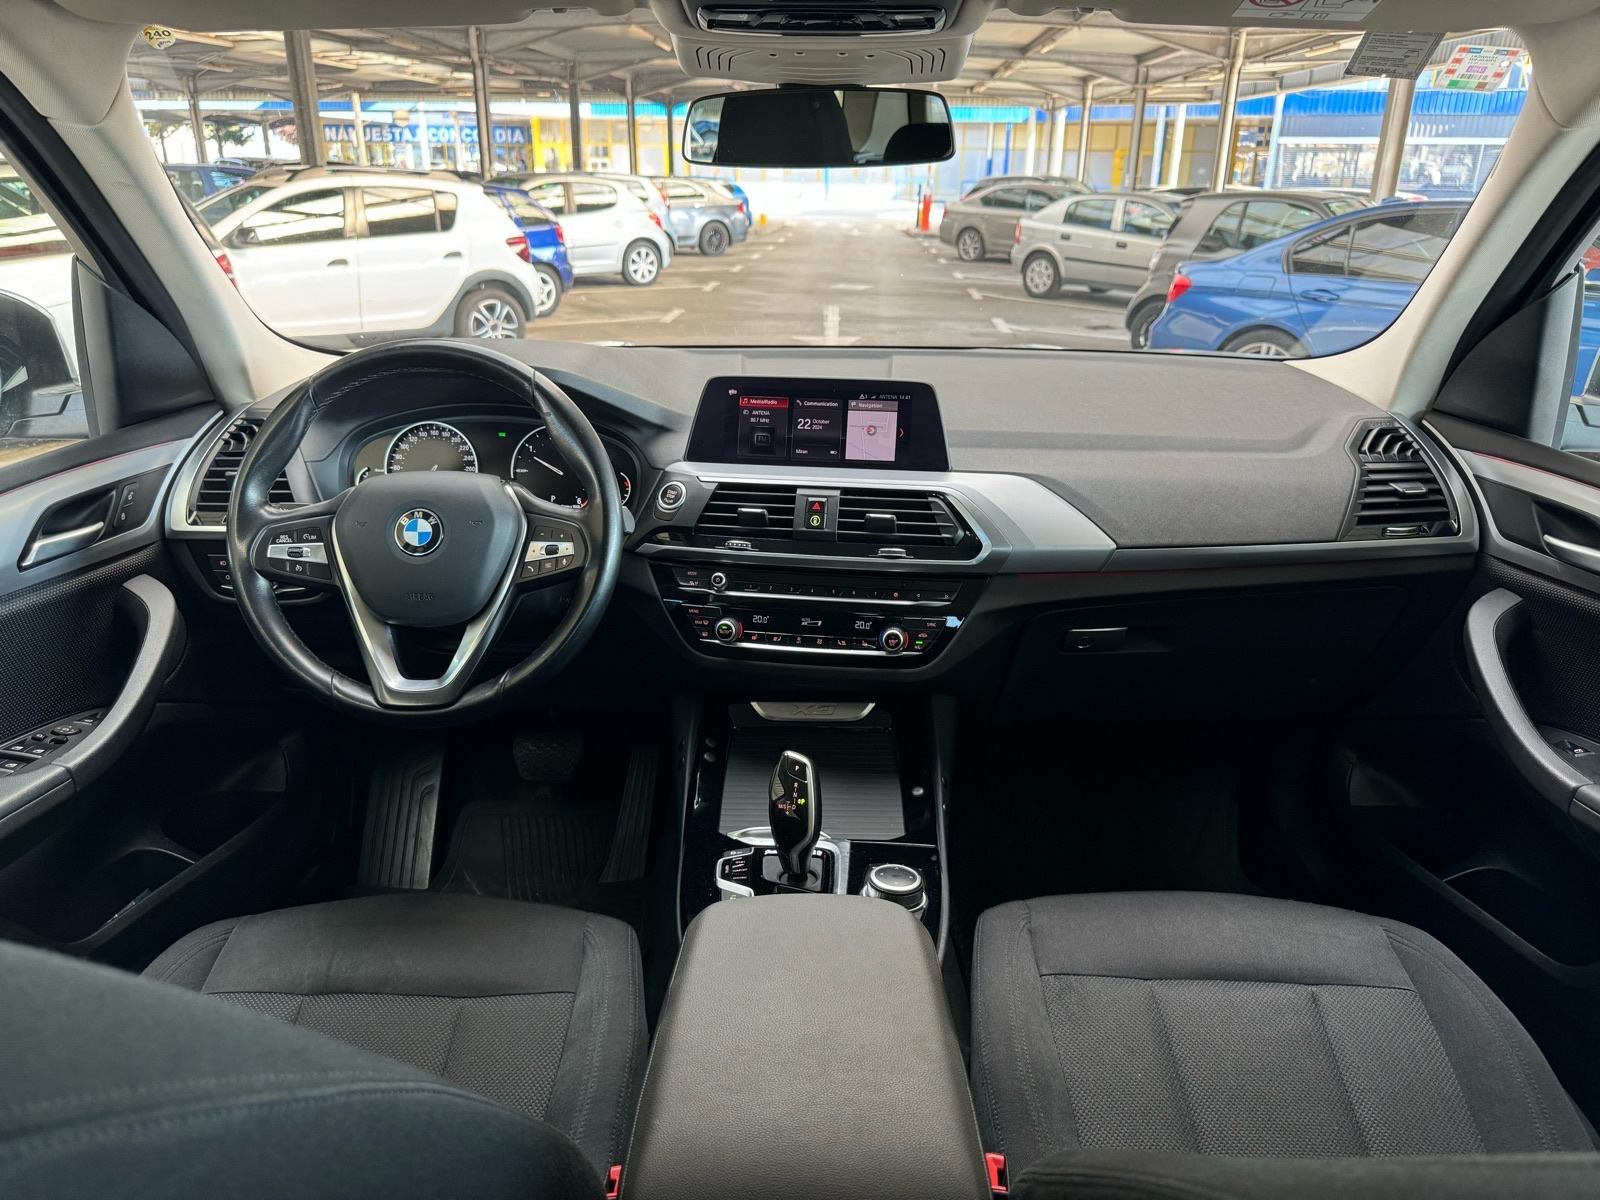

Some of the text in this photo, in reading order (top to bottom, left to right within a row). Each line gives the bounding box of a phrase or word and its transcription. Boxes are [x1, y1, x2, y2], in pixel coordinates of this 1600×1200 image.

[145, 30, 171, 40] 240
[797, 418, 811, 430] 22
[400, 511, 438, 526] BMW
